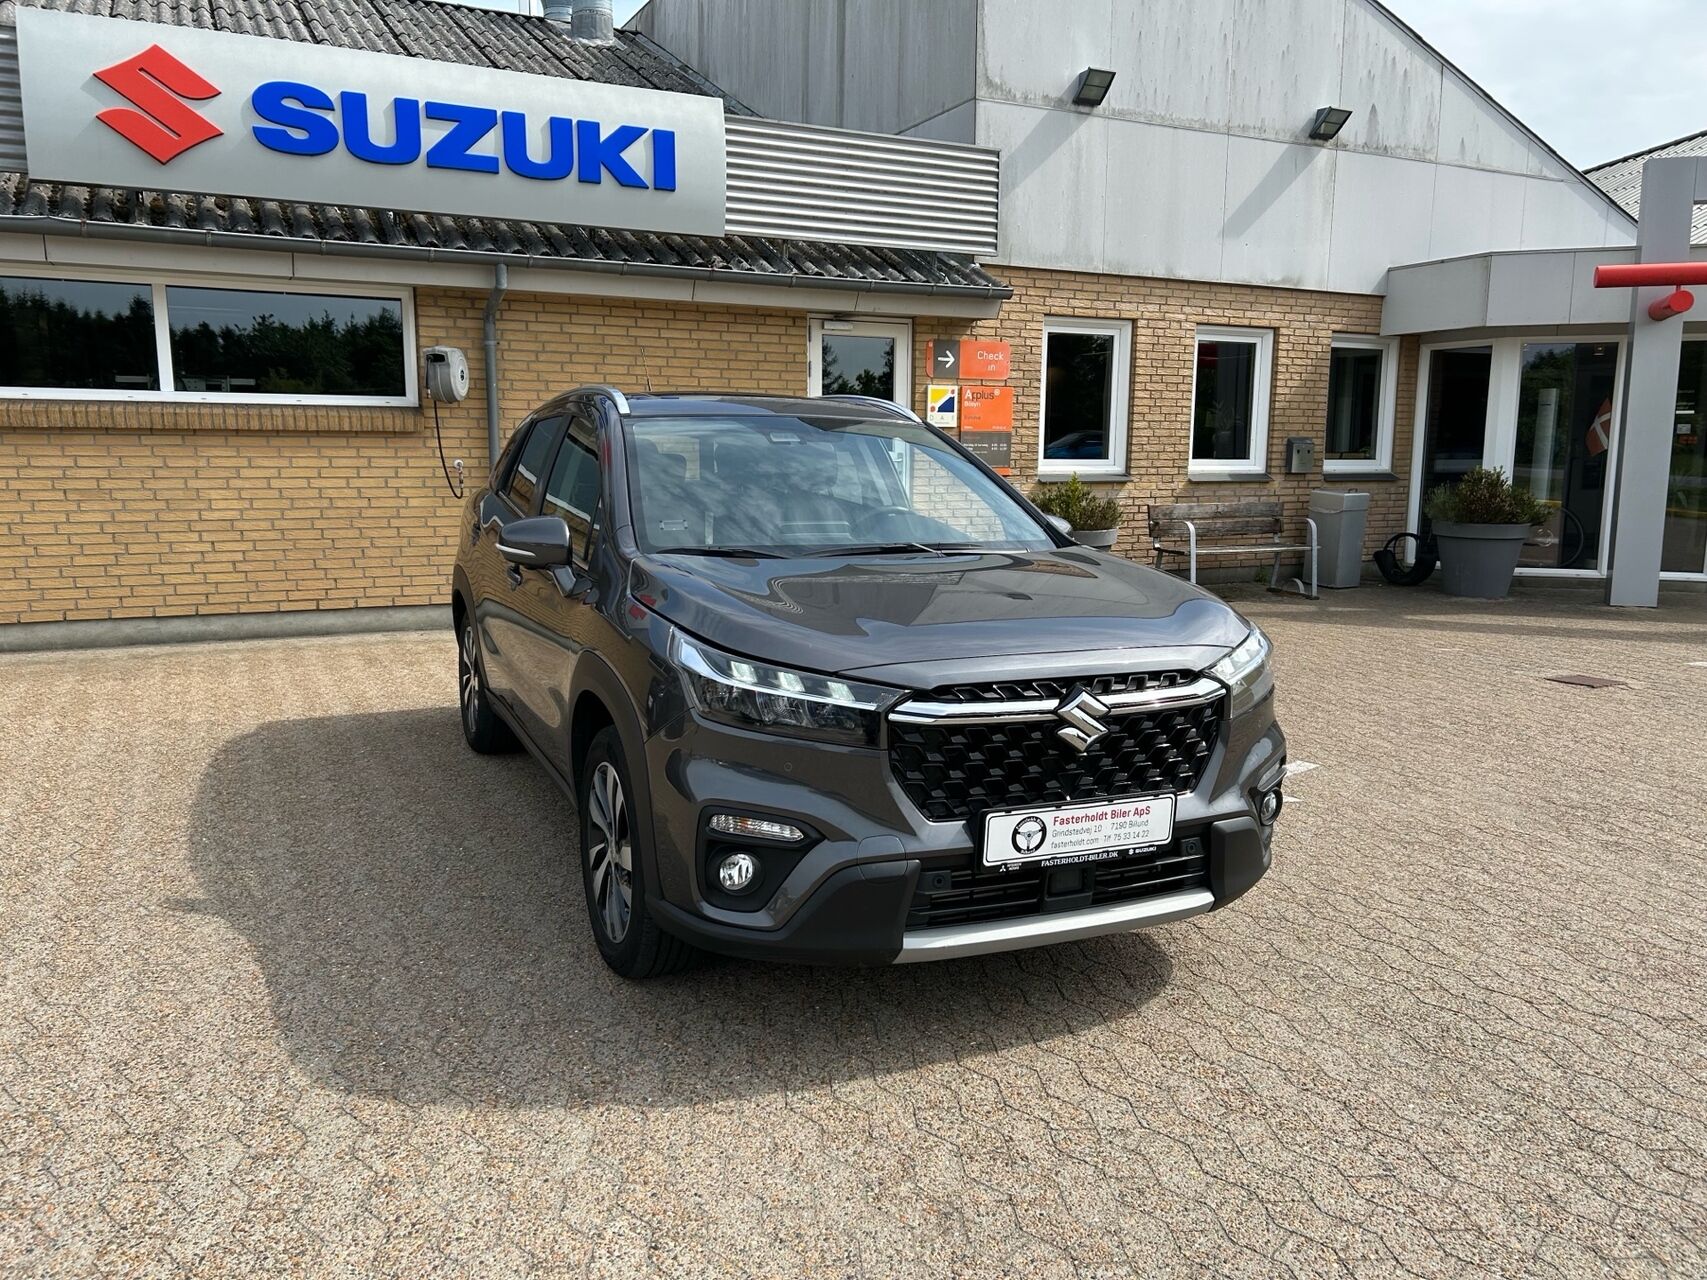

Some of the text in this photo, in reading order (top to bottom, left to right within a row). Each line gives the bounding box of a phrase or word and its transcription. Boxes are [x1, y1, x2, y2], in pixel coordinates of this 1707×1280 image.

[252, 81, 677, 192] SUZUKI
[977, 350, 1004, 360] Check
[987, 363, 996, 371] in
[1053, 805, 1151, 826] Fasterholdt Biler ApS
[1052, 819, 1149, 838] Grindstedvej 10 7190 Billund
[1051, 837, 1100, 849] fasterholdt.com
[1113, 833, 1122, 841] 75
[1123, 832, 1131, 840] 33
[1132, 831, 1140, 839] 14
[1141, 829, 1150, 838] 22
[1041, 850, 1119, 867] FASTERHOLDT-BILER.DK
